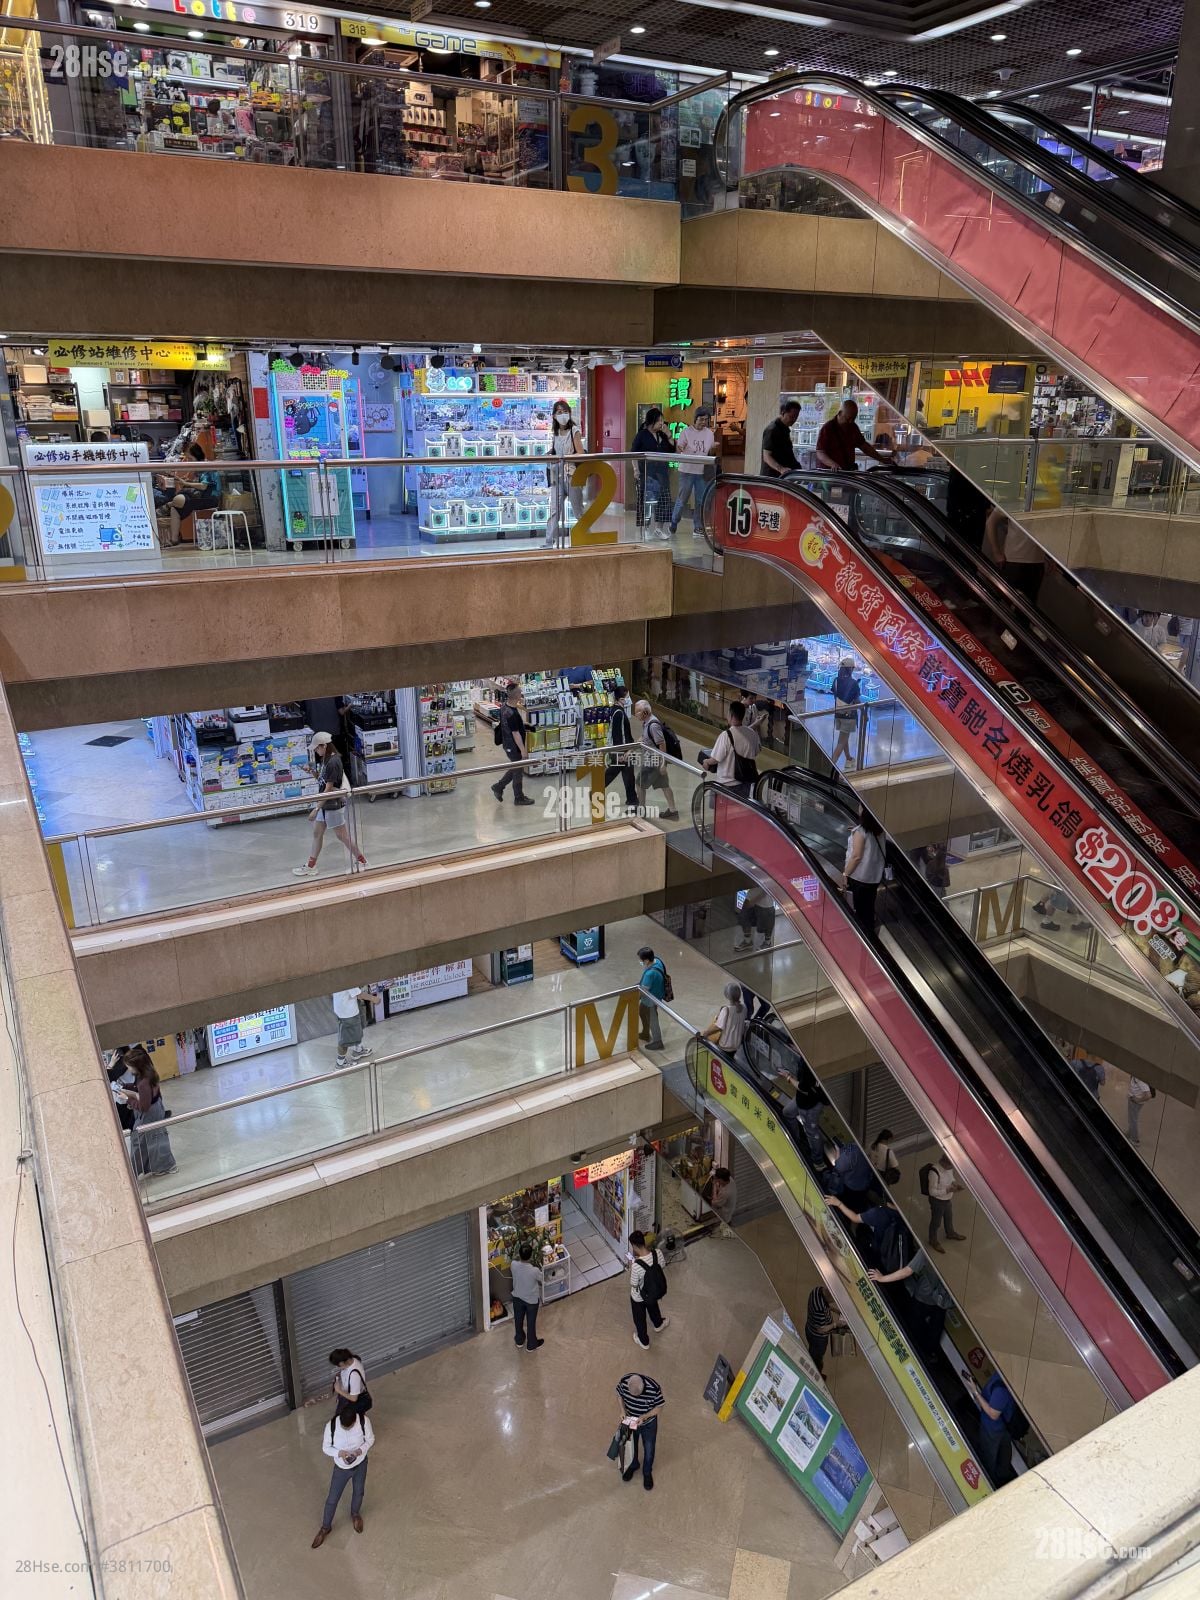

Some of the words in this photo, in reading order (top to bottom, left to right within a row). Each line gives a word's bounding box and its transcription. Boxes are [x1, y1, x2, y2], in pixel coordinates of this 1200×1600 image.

[286, 13, 318, 30] 319
[349, 24, 366, 36] 318
[566, 105, 619, 195] 3
[54, 344, 170, 361] 必修站維修中心
[34, 449, 141, 461] 必修站手機維修中心
[571, 461, 618, 546] 2
[727, 496, 752, 537] 15
[758, 510, 781, 531] 字樓
[1075, 827, 1180, 935] $20.8
[575, 990, 640, 1067] M
